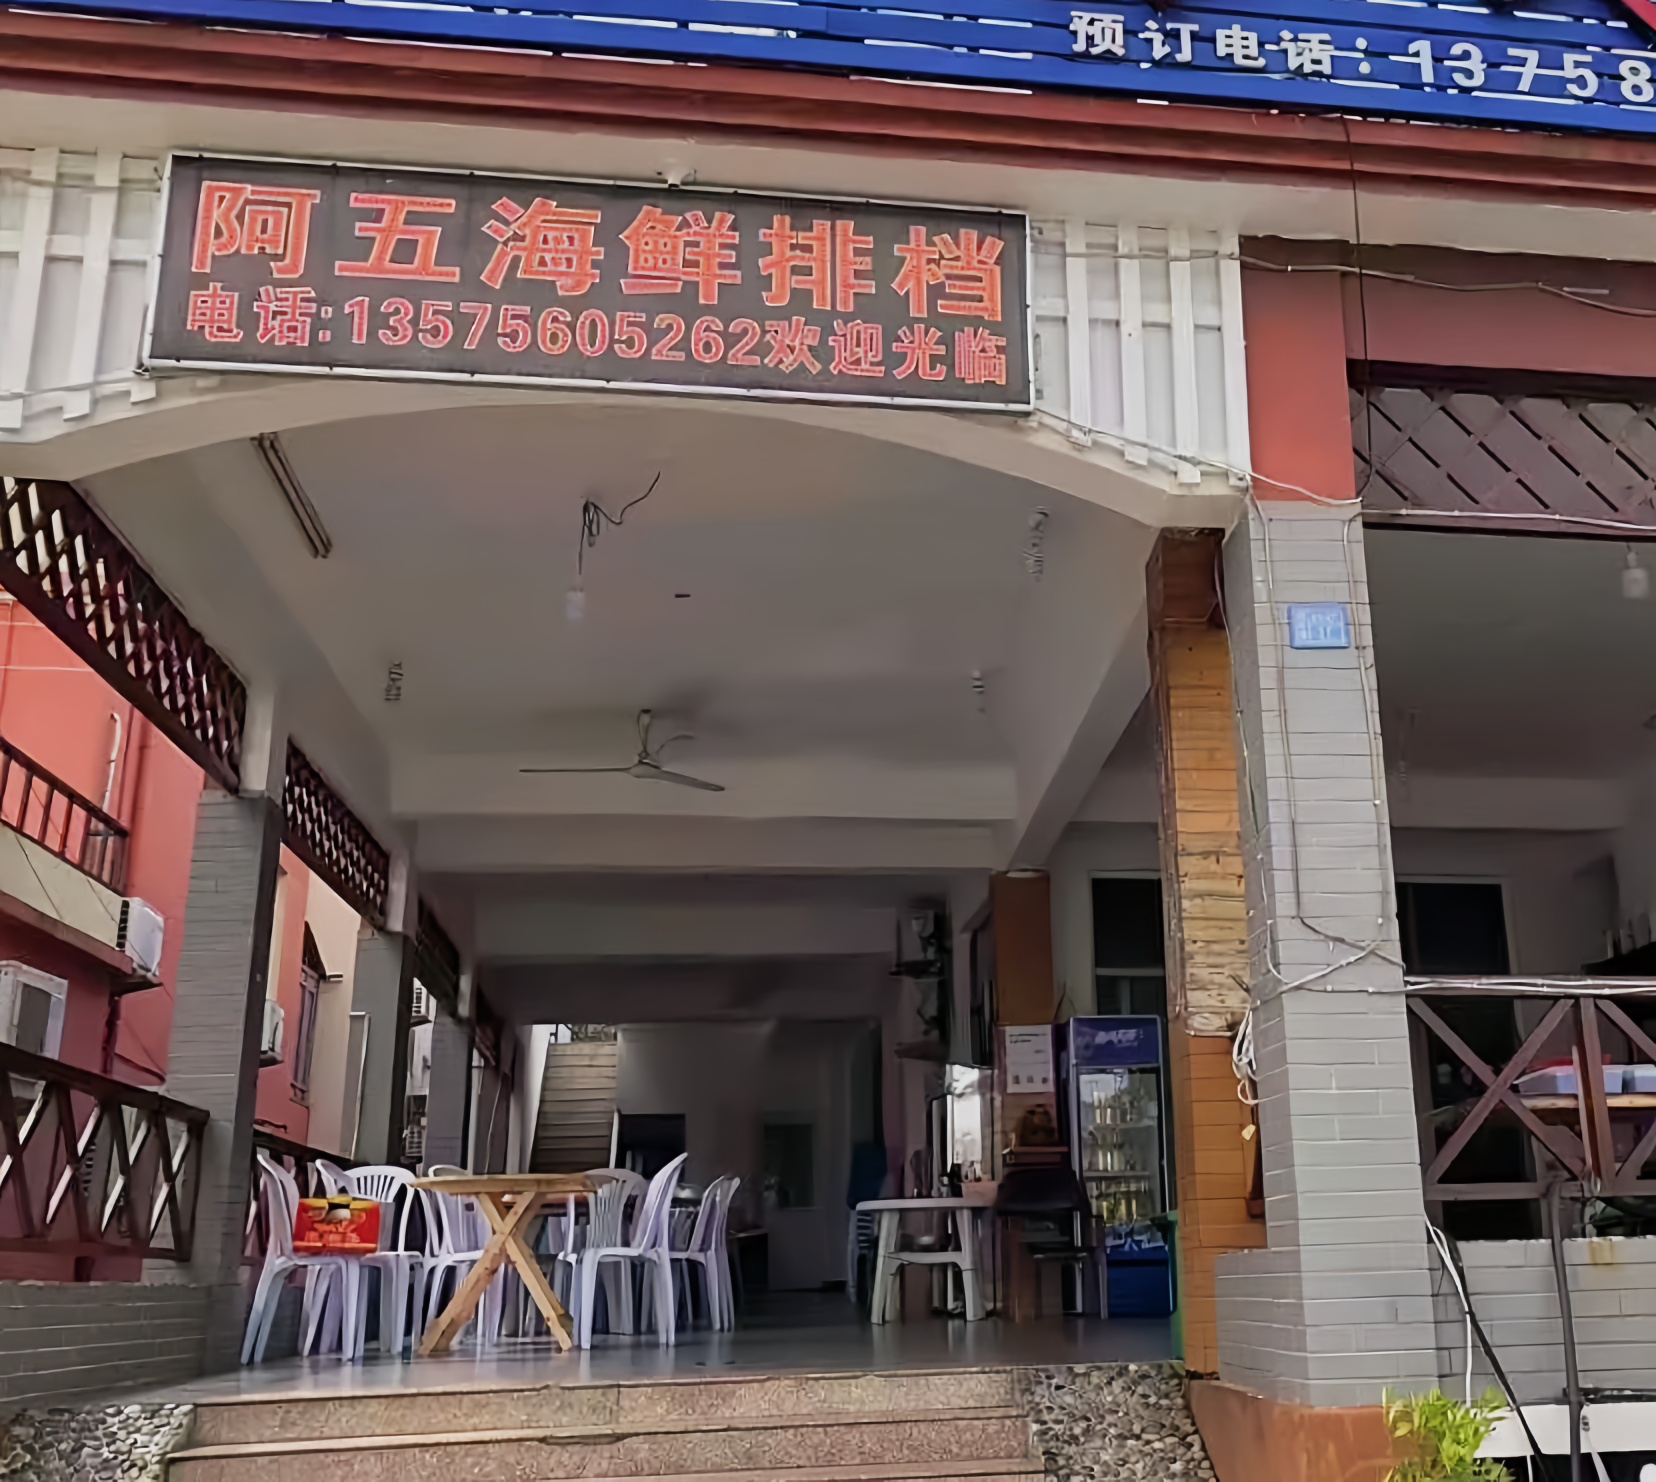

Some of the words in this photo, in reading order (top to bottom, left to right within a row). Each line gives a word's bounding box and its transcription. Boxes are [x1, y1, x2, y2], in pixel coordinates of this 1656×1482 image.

[191, 180, 1005, 321] 阿五海鲜排档
